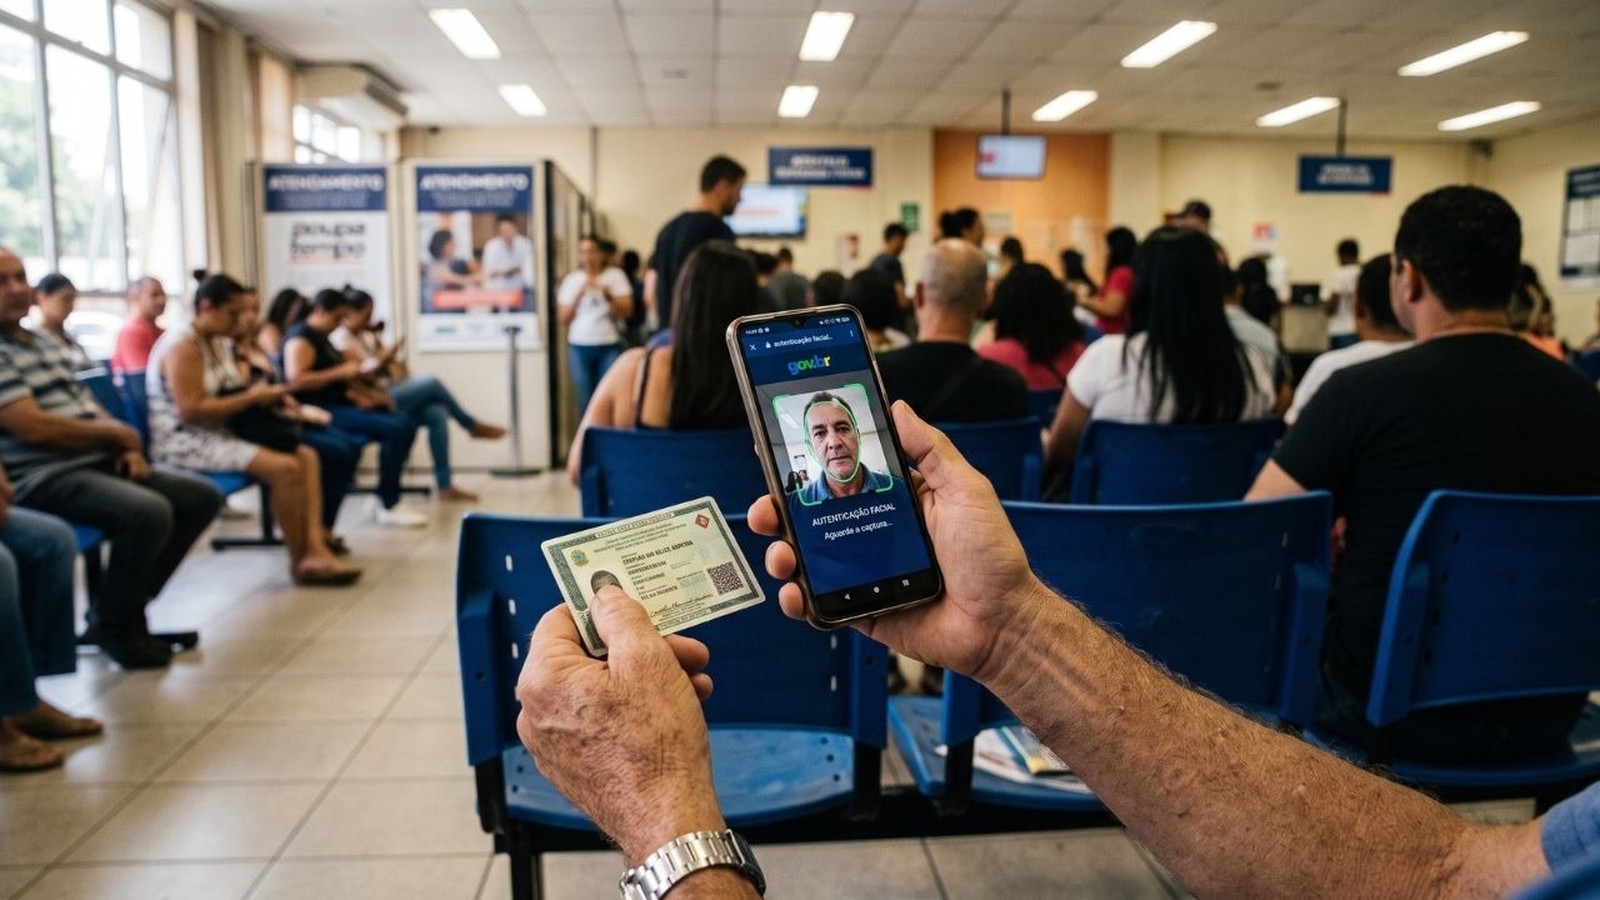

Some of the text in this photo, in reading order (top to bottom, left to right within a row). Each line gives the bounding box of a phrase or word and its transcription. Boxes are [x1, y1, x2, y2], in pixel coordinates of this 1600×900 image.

[788, 354, 831, 375] gov.br
[812, 503, 896, 527] AUTENTICAÇÃO FACIAL
[824, 527, 854, 541] Aguarde
